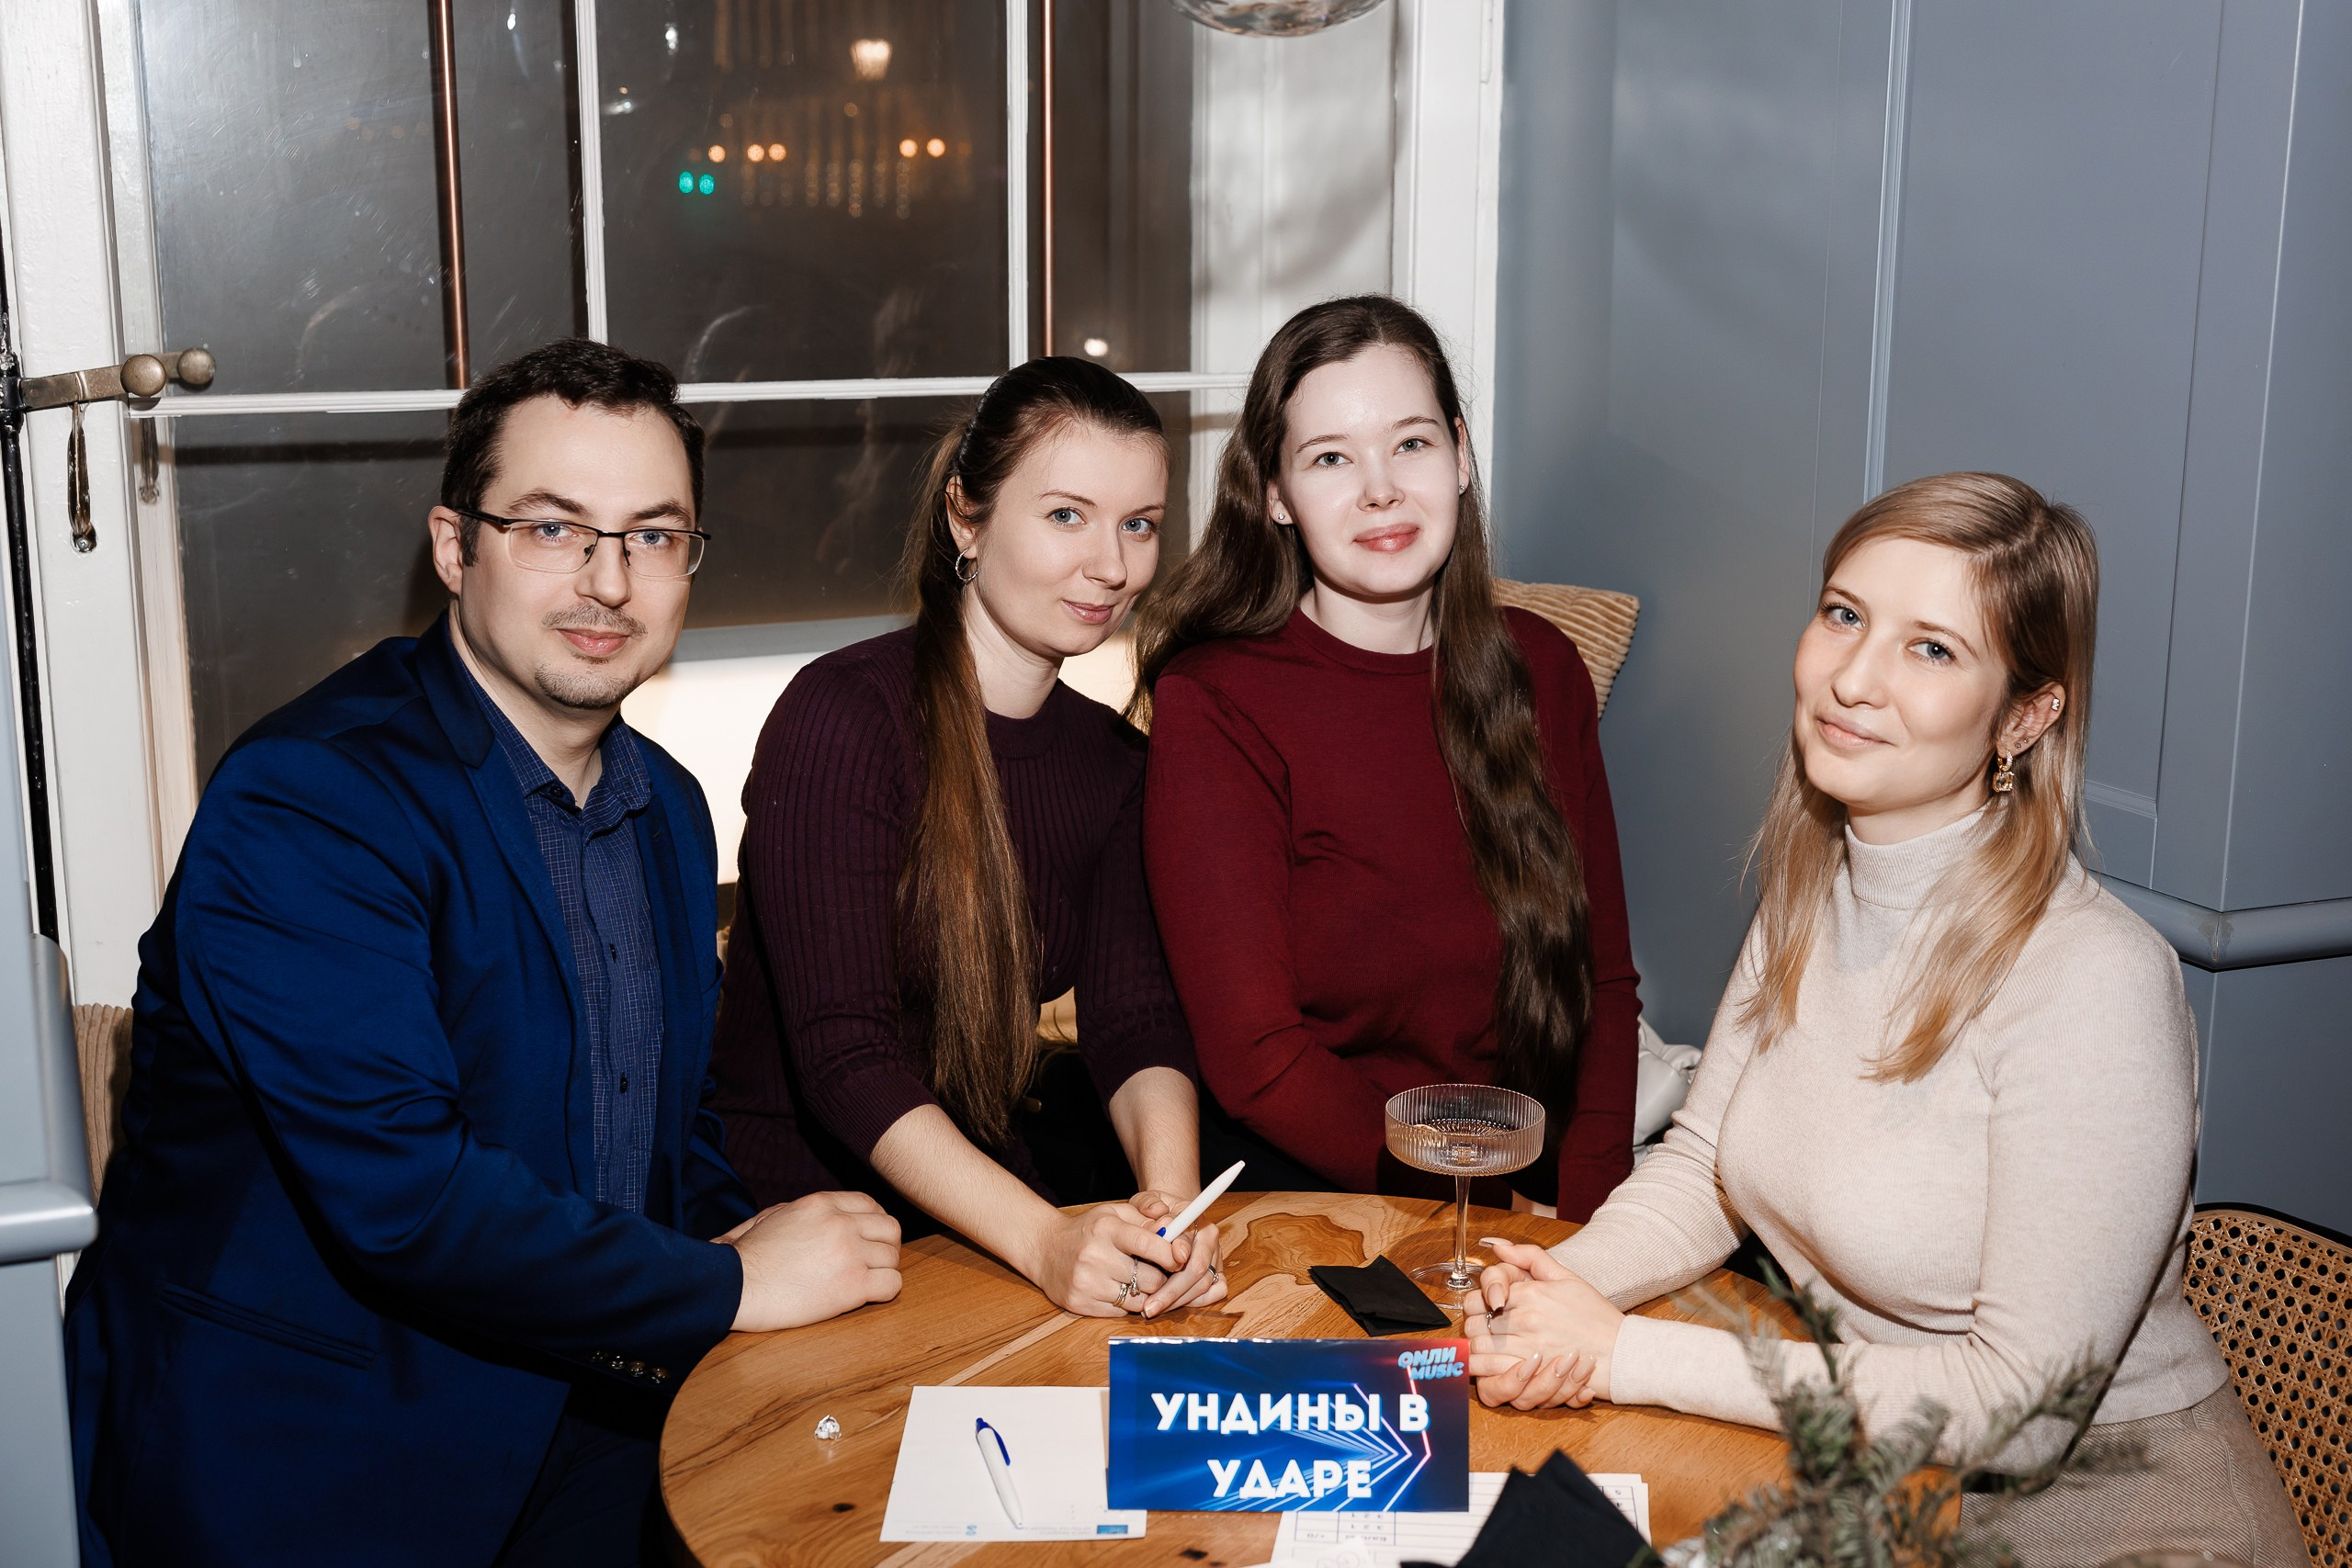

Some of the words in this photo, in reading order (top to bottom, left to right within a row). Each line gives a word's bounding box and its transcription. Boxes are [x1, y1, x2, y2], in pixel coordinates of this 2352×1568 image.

[1410, 1363, 1464, 1380] MUSIC
[1151, 1393, 1380, 1435] УНДИНЫ
[1399, 1393, 1429, 1432] В
[1207, 1460, 1372, 1498] УДАРЕ
